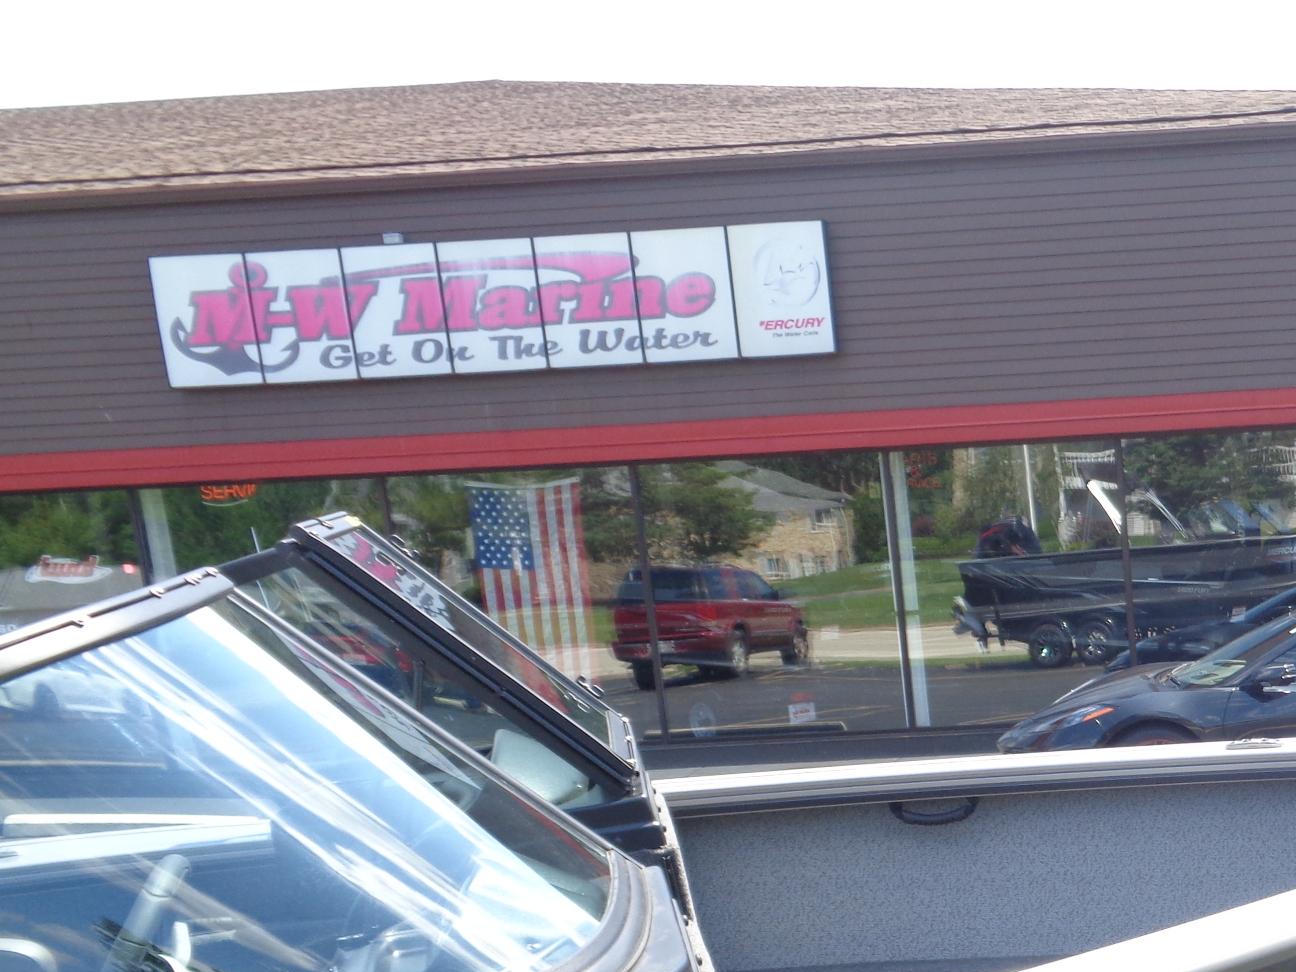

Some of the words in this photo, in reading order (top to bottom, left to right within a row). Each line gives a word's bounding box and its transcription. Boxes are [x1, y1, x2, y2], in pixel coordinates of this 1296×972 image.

[187, 278, 380, 348] M-W
[392, 264, 716, 337] Marine
[319, 342, 397, 370] Get
[411, 338, 475, 364] On
[489, 335, 563, 361] The
[579, 327, 718, 355] Water
